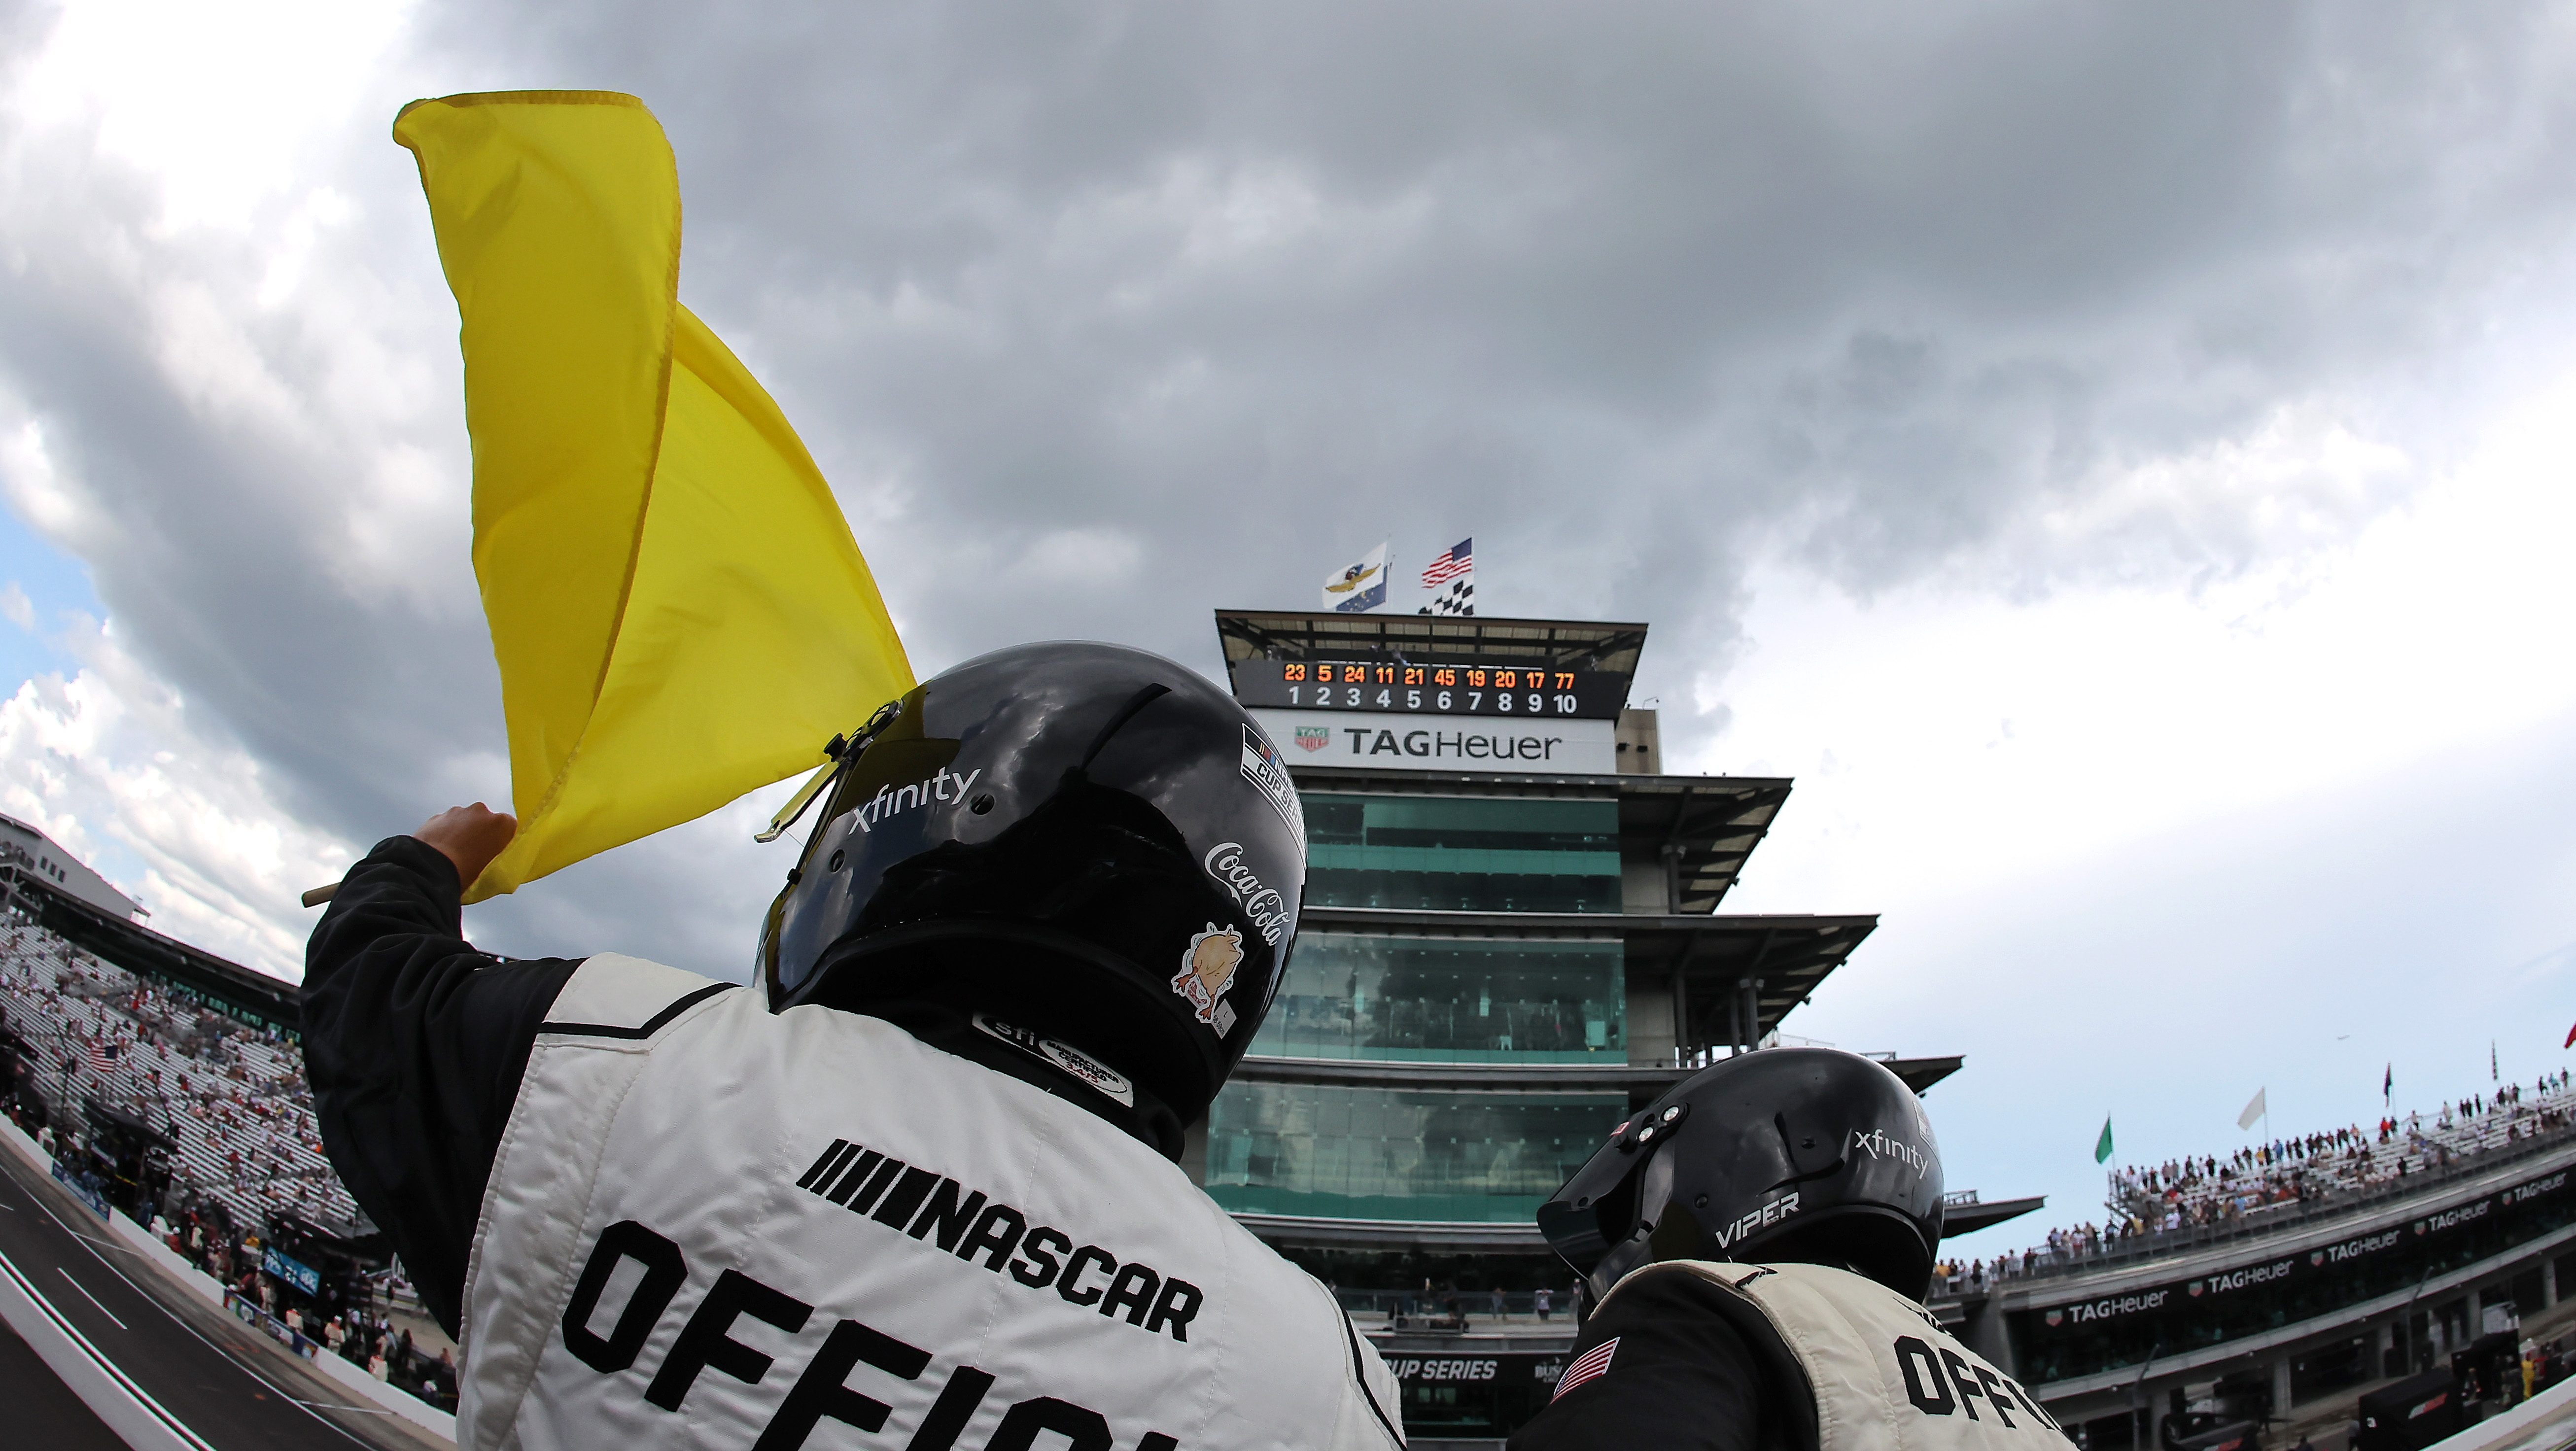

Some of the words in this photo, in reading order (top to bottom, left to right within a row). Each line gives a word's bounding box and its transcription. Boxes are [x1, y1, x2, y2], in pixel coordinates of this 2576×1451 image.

[1285, 664, 1305, 681] 23
[1318, 665, 1332, 682] 5
[1344, 666, 1365, 683] 24
[1376, 667, 1393, 684] 11
[1405, 668, 1424, 685] 21
[1434, 669, 1455, 686] 45
[1466, 670, 1486, 687] 19
[1495, 671, 1516, 688] 20
[1527, 672, 1545, 689] 17
[1555, 672, 1575, 689] 77
[1288, 686, 1299, 705] 1
[1316, 686, 1331, 706] 2
[1346, 687, 1361, 707] 3
[1376, 689, 1392, 708] 4
[1407, 690, 1422, 709] 5
[1437, 691, 1452, 710] 6
[1468, 691, 1482, 711] 7
[1497, 692, 1513, 712] 8
[1528, 693, 1543, 713] 9
[1553, 694, 1577, 714] 10
[848, 767, 981, 835] xfinity
[1257, 762, 1282, 792] CUP
[1282, 790, 1304, 834] SERIE
[1047, 1041, 1119, 1083] MANUFACTURER
[1058, 1051, 1107, 1082] CERTIFIED
[1855, 1129, 1928, 1179] xfinity
[1715, 1192, 1800, 1248] VIPER
[907, 1177, 1203, 1342] NASCAR
[561, 1220, 1179, 1451] OFFI
[1422, 1359, 1498, 1381] SERIES
[1894, 1335, 2063, 1432] OFFI
